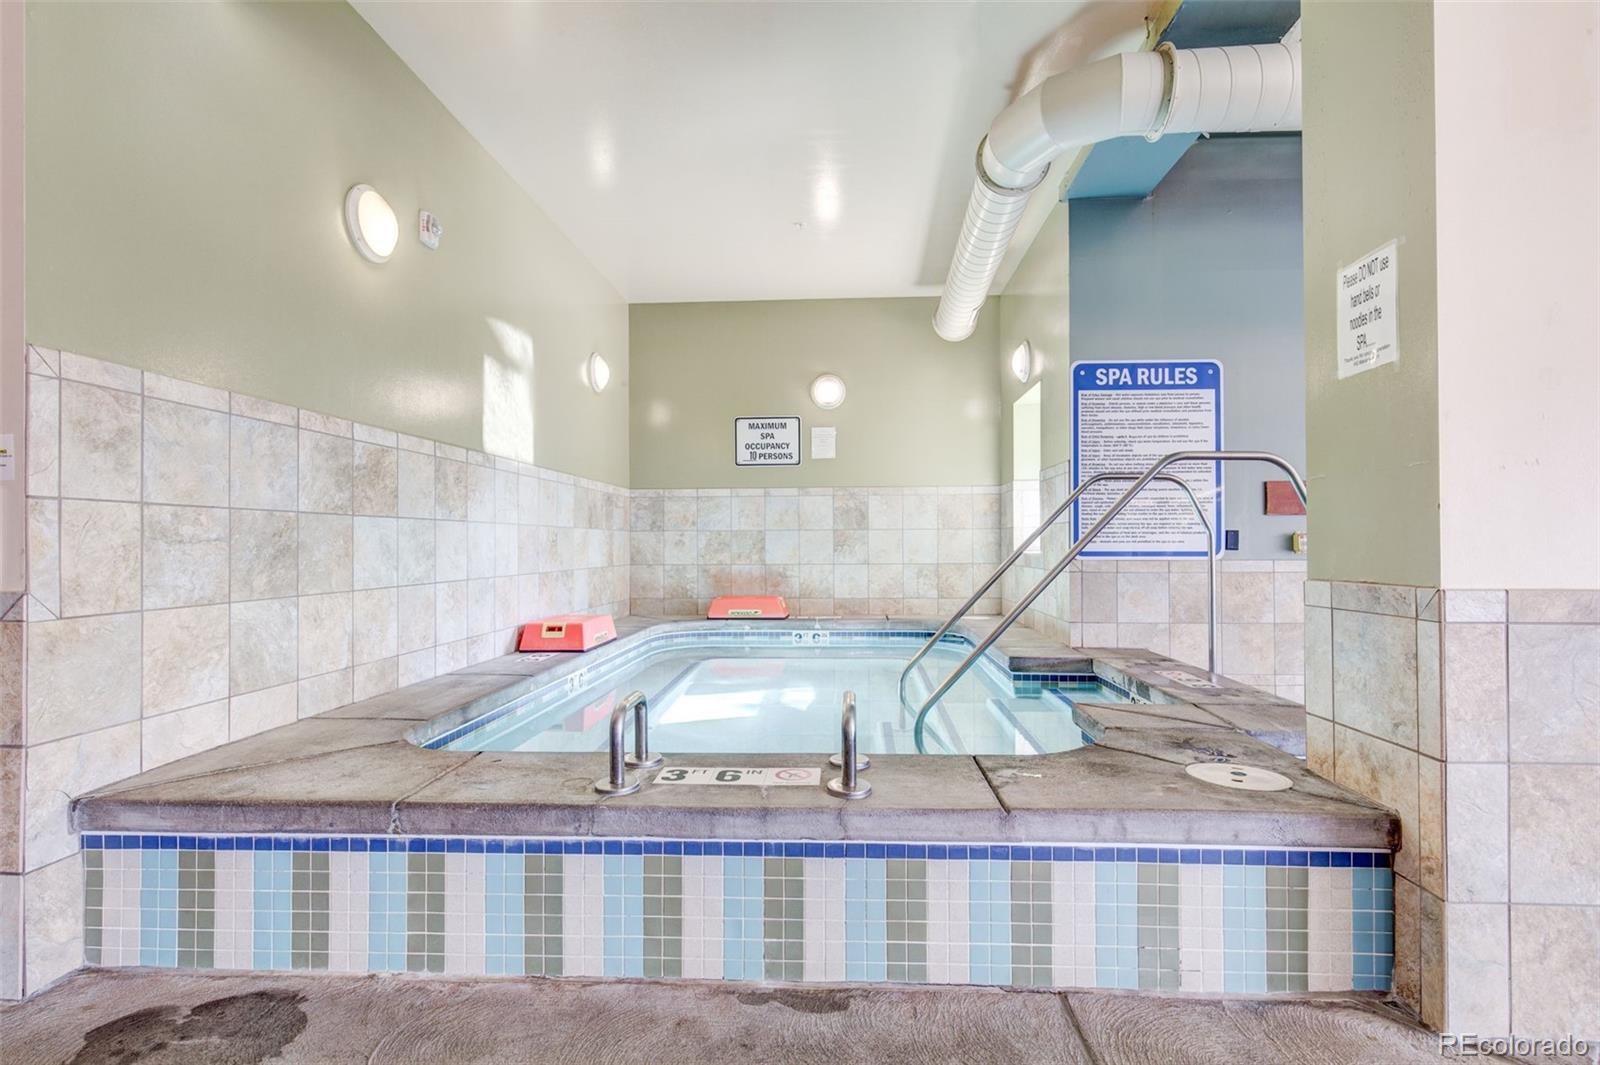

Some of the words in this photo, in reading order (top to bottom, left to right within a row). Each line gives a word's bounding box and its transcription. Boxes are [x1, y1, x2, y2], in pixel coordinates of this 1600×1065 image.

[1342, 272, 1358, 290] Please
[1359, 263, 1366, 282] DO
[1366, 257, 1378, 277] NOT
[1379, 255, 1389, 271] use
[1350, 288, 1362, 308] hand
[1374, 283, 1380, 298] or
[1350, 311, 1368, 331] noodles
[1373, 304, 1382, 321] the
[1095, 367, 1132, 386] SPA
[1137, 367, 1198, 386] RULES
[748, 422, 787, 430] MAXIMUM
[760, 432, 775, 440] SPA
[744, 442, 790, 450] OCCUPANCY
[749, 450, 757, 461] 10
[758, 452, 793, 460] PERSONS
[661, 769, 688, 782] 3
[715, 769, 743, 782] 6
